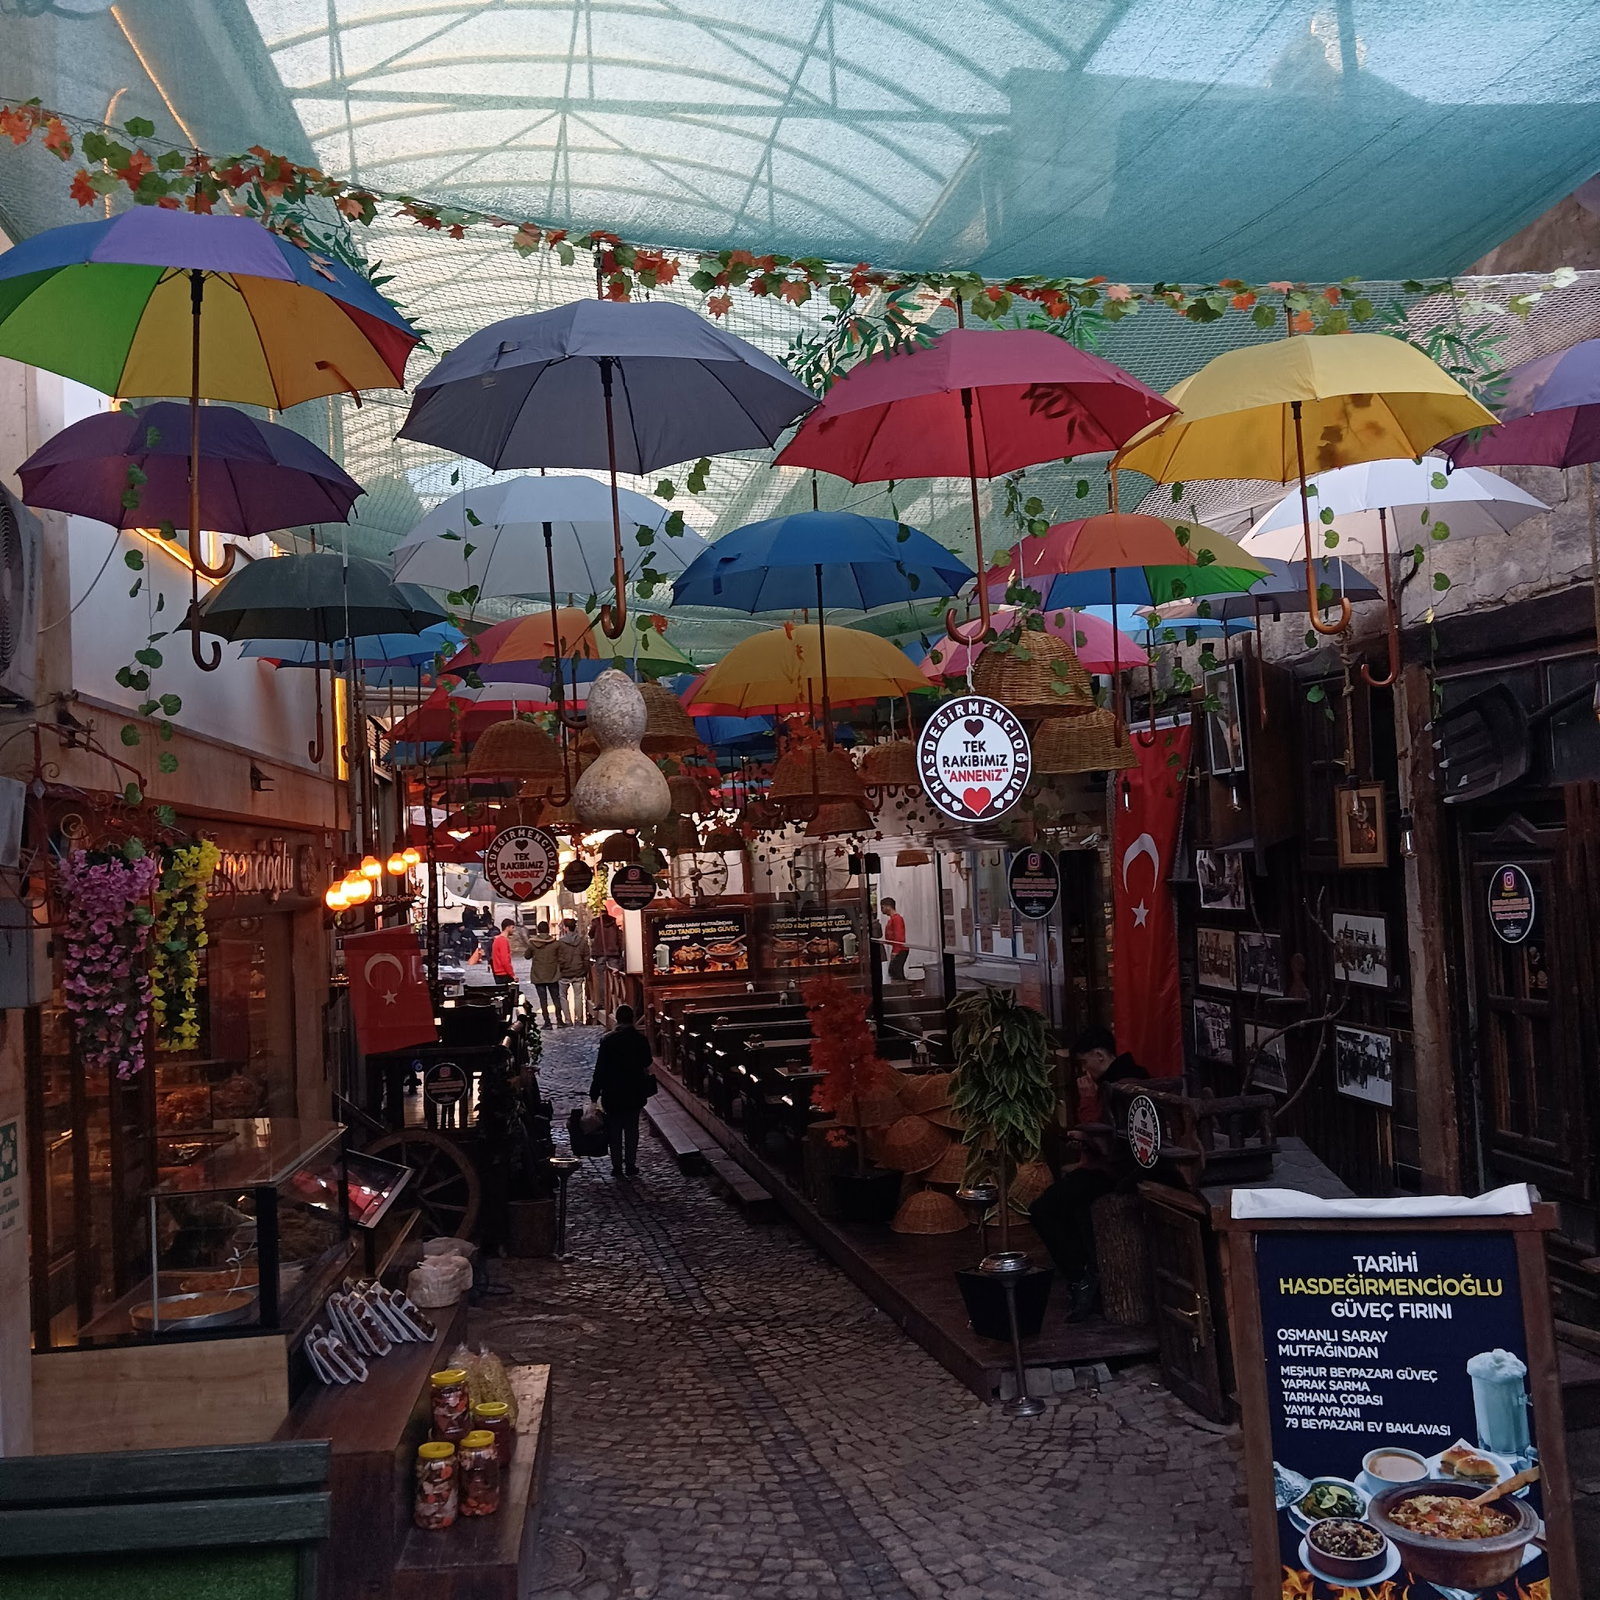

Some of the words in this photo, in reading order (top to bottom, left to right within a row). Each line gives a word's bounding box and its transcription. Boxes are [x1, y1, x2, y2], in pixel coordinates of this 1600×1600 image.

[923, 701, 1028, 793] HASDEĞİRMENCİOĞLU
[963, 740, 987, 753] TEK
[942, 754, 1008, 768] RAKİBİMİZ
[944, 768, 1009, 783] "ANNENİZ"
[513, 853, 530, 861] TEK
[1353, 1251, 1418, 1273] TARİHİ
[1279, 1274, 1503, 1297] HASDEĞİRMENCİOĞLU
[1331, 1298, 1394, 1321] GÜVEÇ
[1400, 1303, 1452, 1319] FIRINI
[1277, 1328, 1338, 1342] OSMANLI
[1341, 1330, 1388, 1343] SARAY
[1278, 1343, 1379, 1359] MUTFAĞINDAN
[1280, 1366, 1327, 1378] MEŞHUR
[1330, 1367, 1393, 1380] BEYPAZARI
[1396, 1367, 1438, 1383] GÜVEÇ
[1281, 1379, 1327, 1390] YAPRAK
[1329, 1380, 1370, 1392] SARMA
[1282, 1391, 1337, 1404] TARHANA
[1340, 1393, 1383, 1406] ÇOBASI
[1283, 1404, 1316, 1416] YAYIK
[1318, 1406, 1361, 1418] AYRANI
[1284, 1417, 1298, 1429] 79
[1301, 1419, 1364, 1432] BEYPAZARI
[1367, 1422, 1383, 1433] EV
[1386, 1423, 1451, 1437] BAKLAVASI
